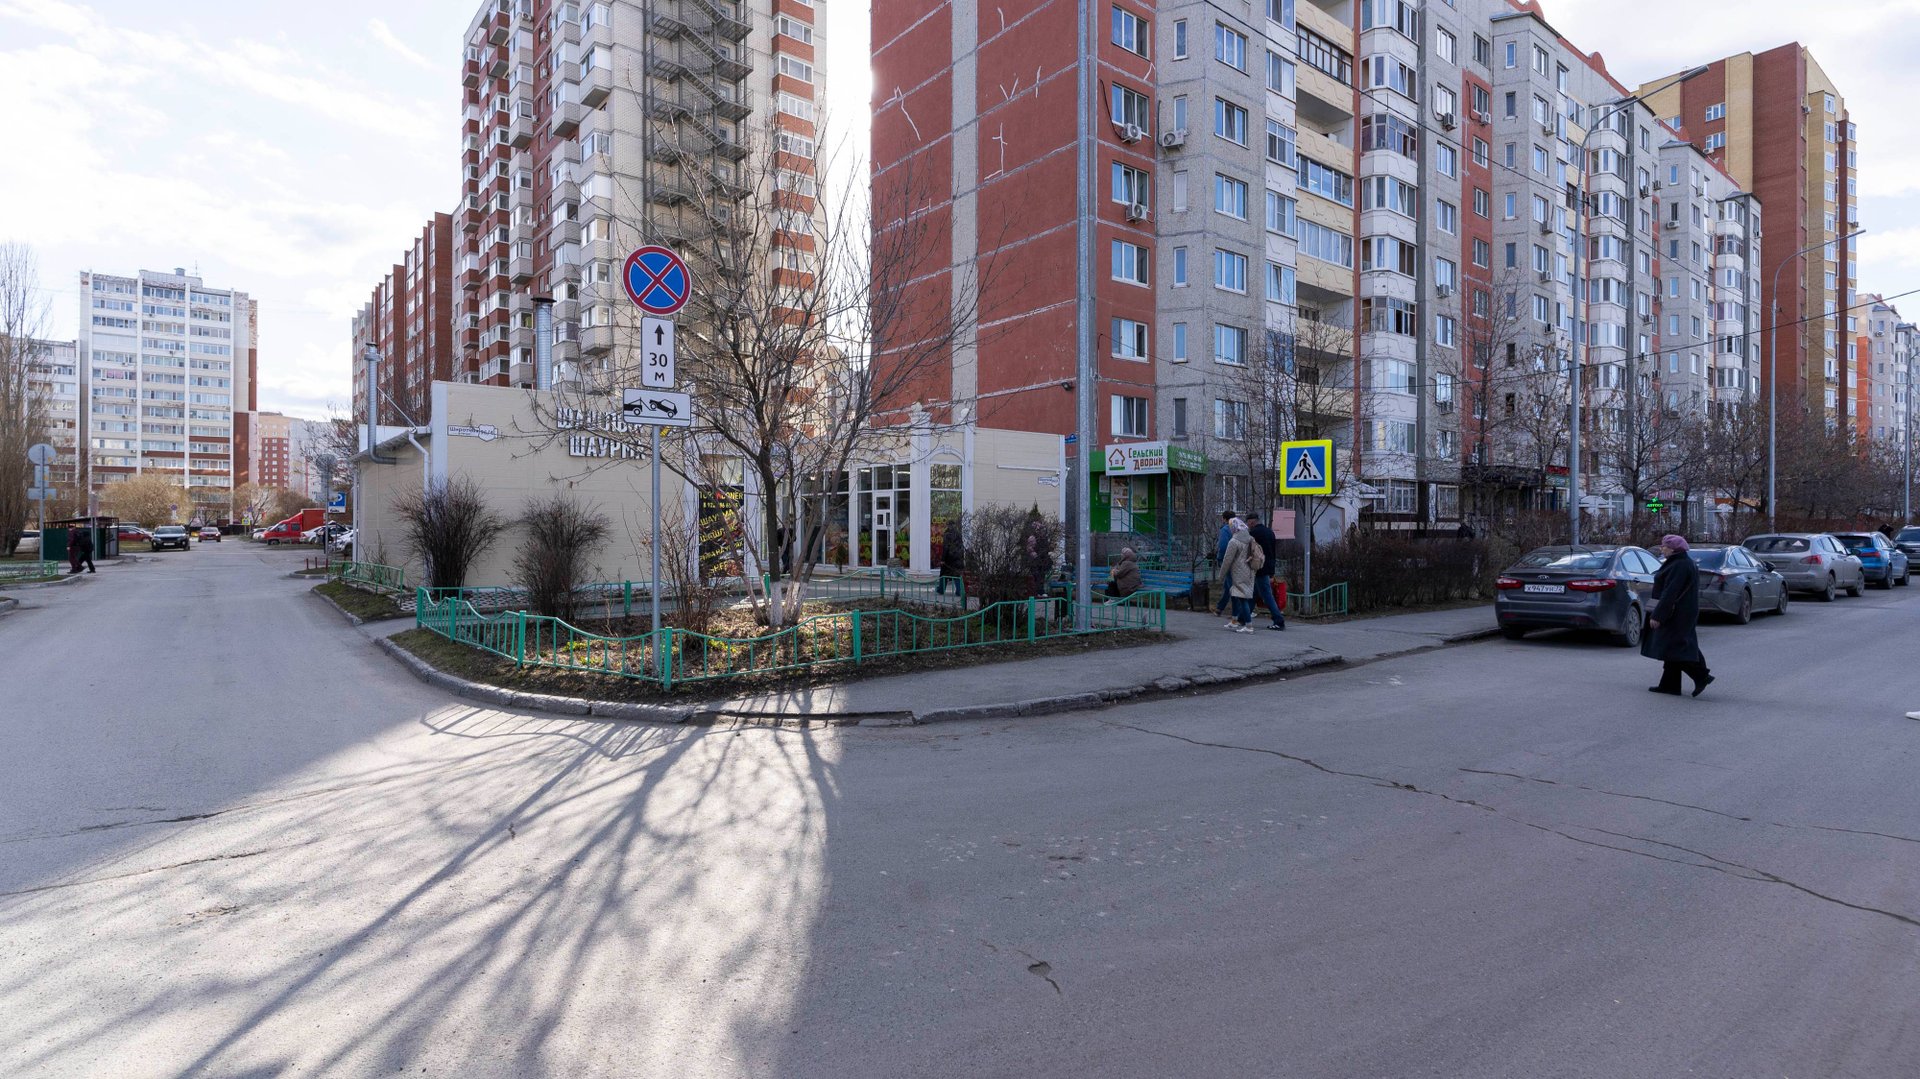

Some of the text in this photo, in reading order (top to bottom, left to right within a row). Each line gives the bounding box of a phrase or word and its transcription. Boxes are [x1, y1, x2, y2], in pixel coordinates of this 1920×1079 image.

[649, 352, 668, 368] 30
[557, 408, 642, 433] ШАШЛЫ
[569, 436, 645, 460] ШАУРМА
[1128, 446, 1163, 458] Сельский
[1133, 457, 1163, 471] Дворик
[700, 509, 735, 526] ШАУМА
